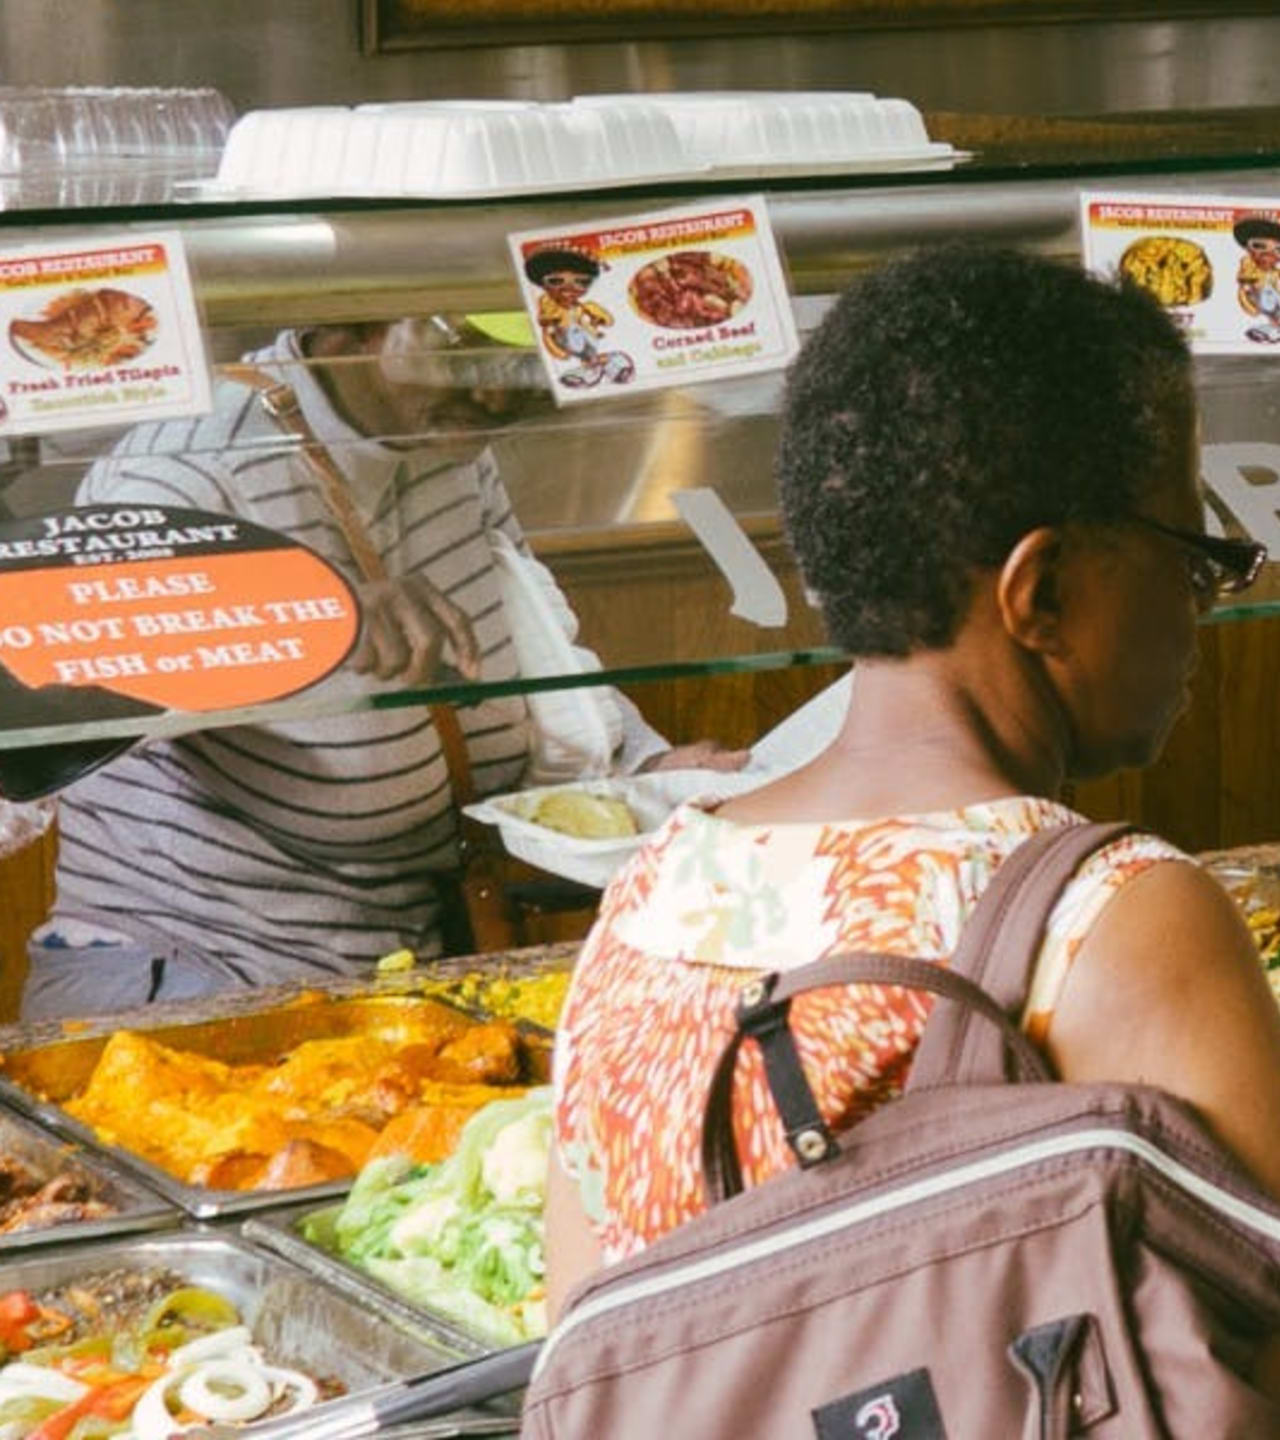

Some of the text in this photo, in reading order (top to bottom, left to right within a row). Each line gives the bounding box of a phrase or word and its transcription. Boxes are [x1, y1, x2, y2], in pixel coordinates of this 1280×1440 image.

[43, 509, 167, 538] JACOB
[67, 571, 217, 606] PLEASE
[40, 617, 130, 647] NOT
[133, 604, 268, 638] BREAK
[265, 597, 348, 626] THE
[54, 638, 306, 685] FISH or MEAT
